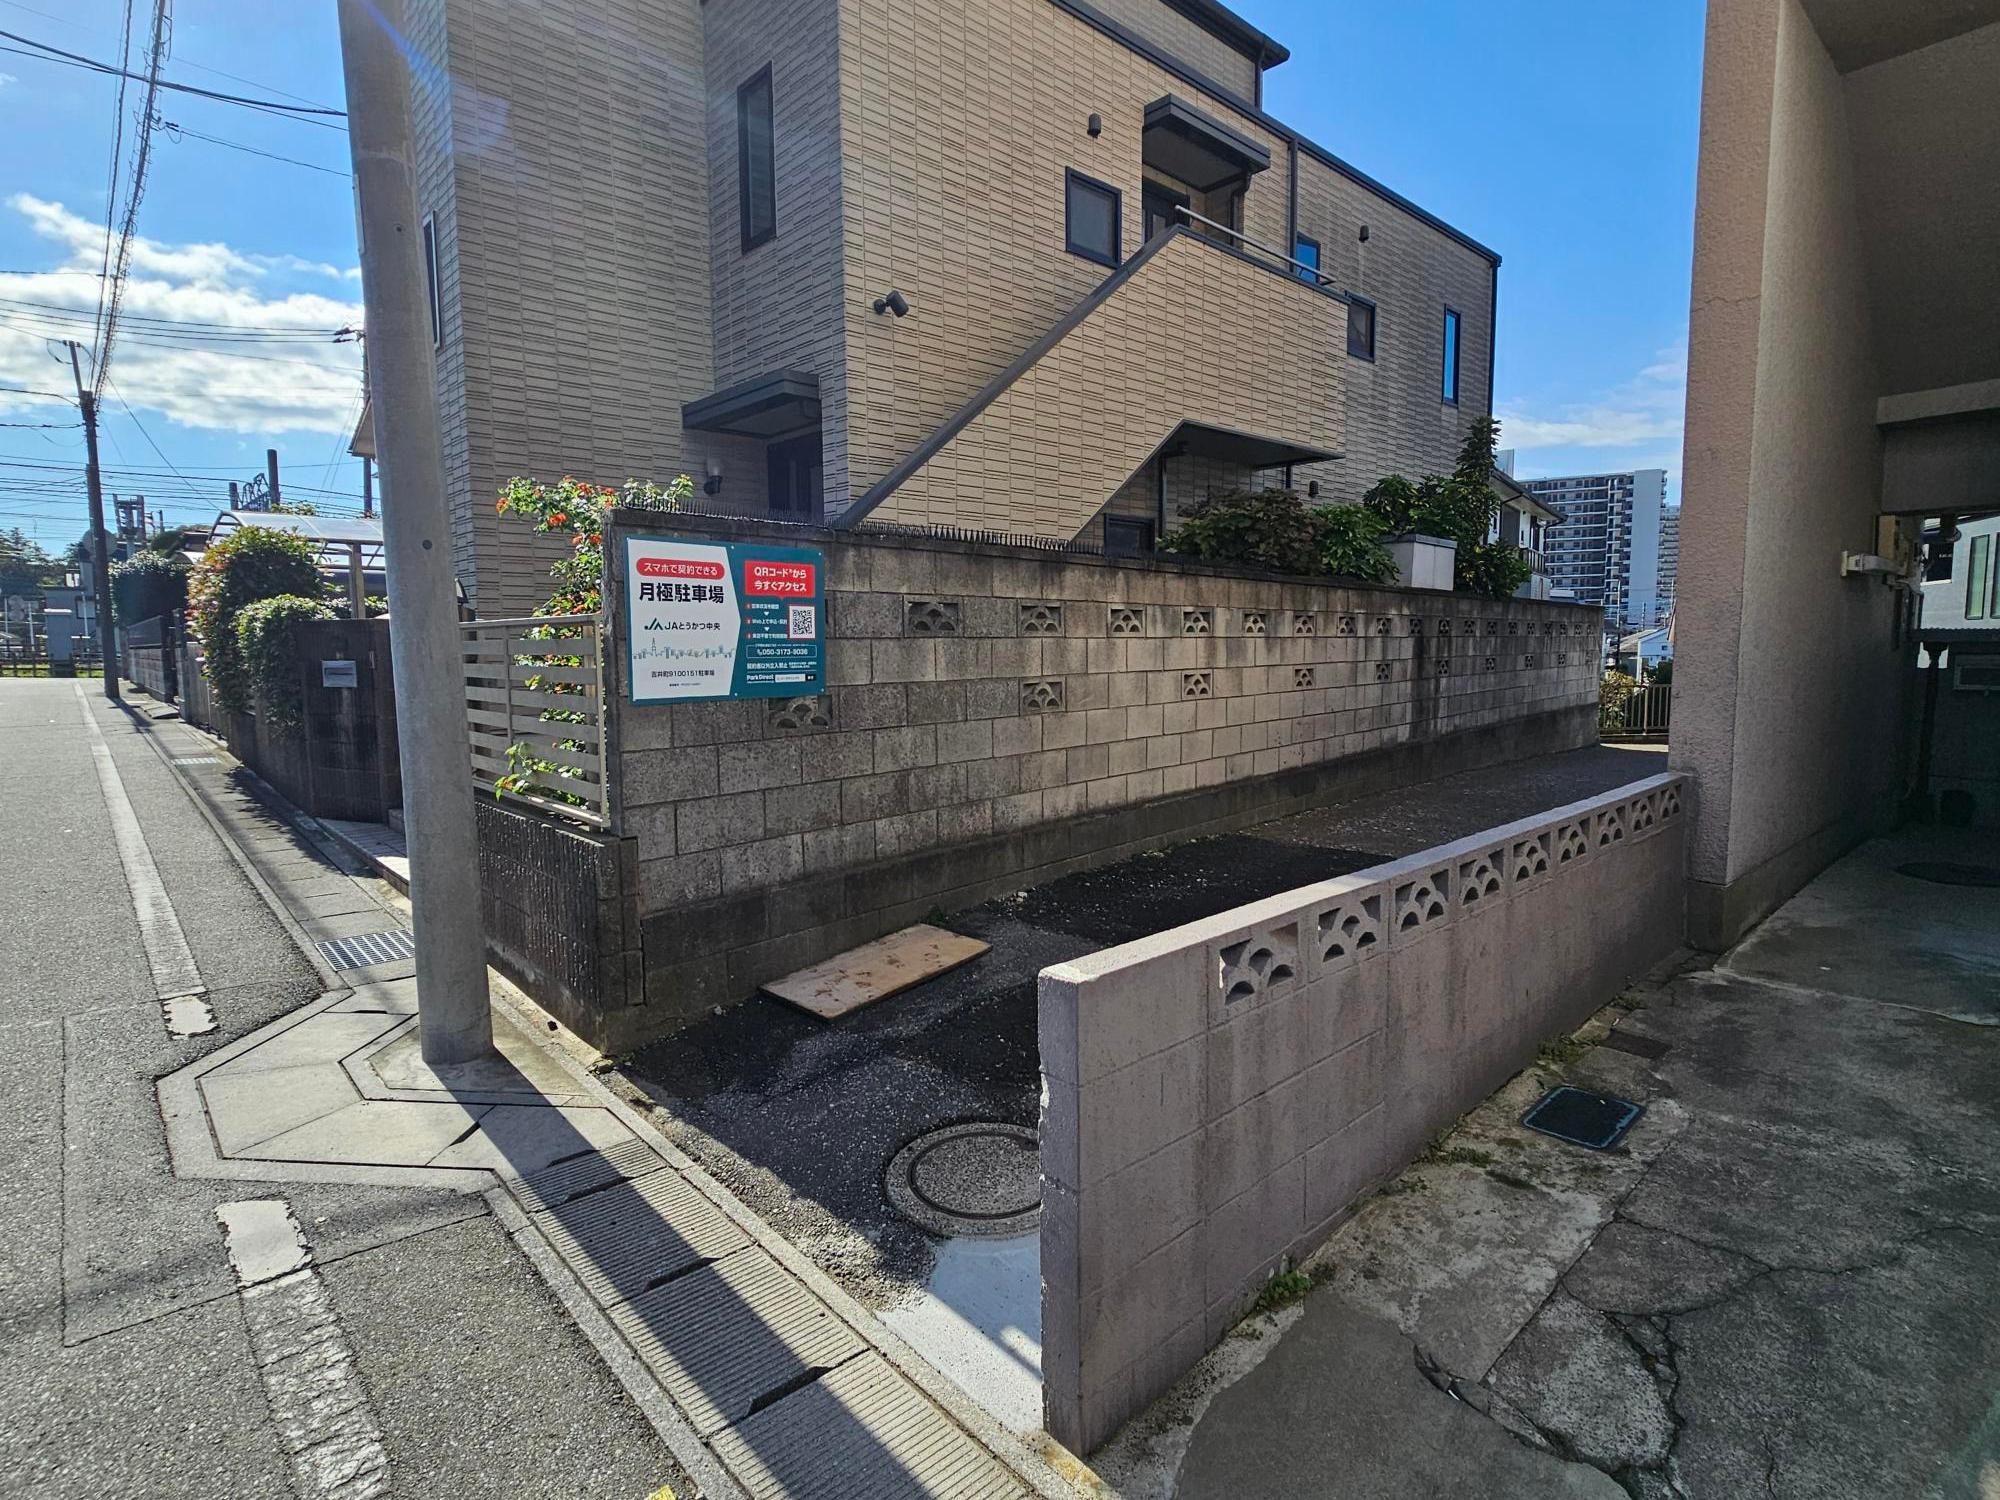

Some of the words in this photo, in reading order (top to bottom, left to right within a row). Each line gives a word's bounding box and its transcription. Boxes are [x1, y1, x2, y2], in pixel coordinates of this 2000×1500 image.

[644, 562, 717, 576] スマホで契約できる
[639, 583, 725, 603] 月極駐車場
[754, 580, 807, 593] 今すぐアクセス
[664, 621, 721, 631] JAとうかつ中央
